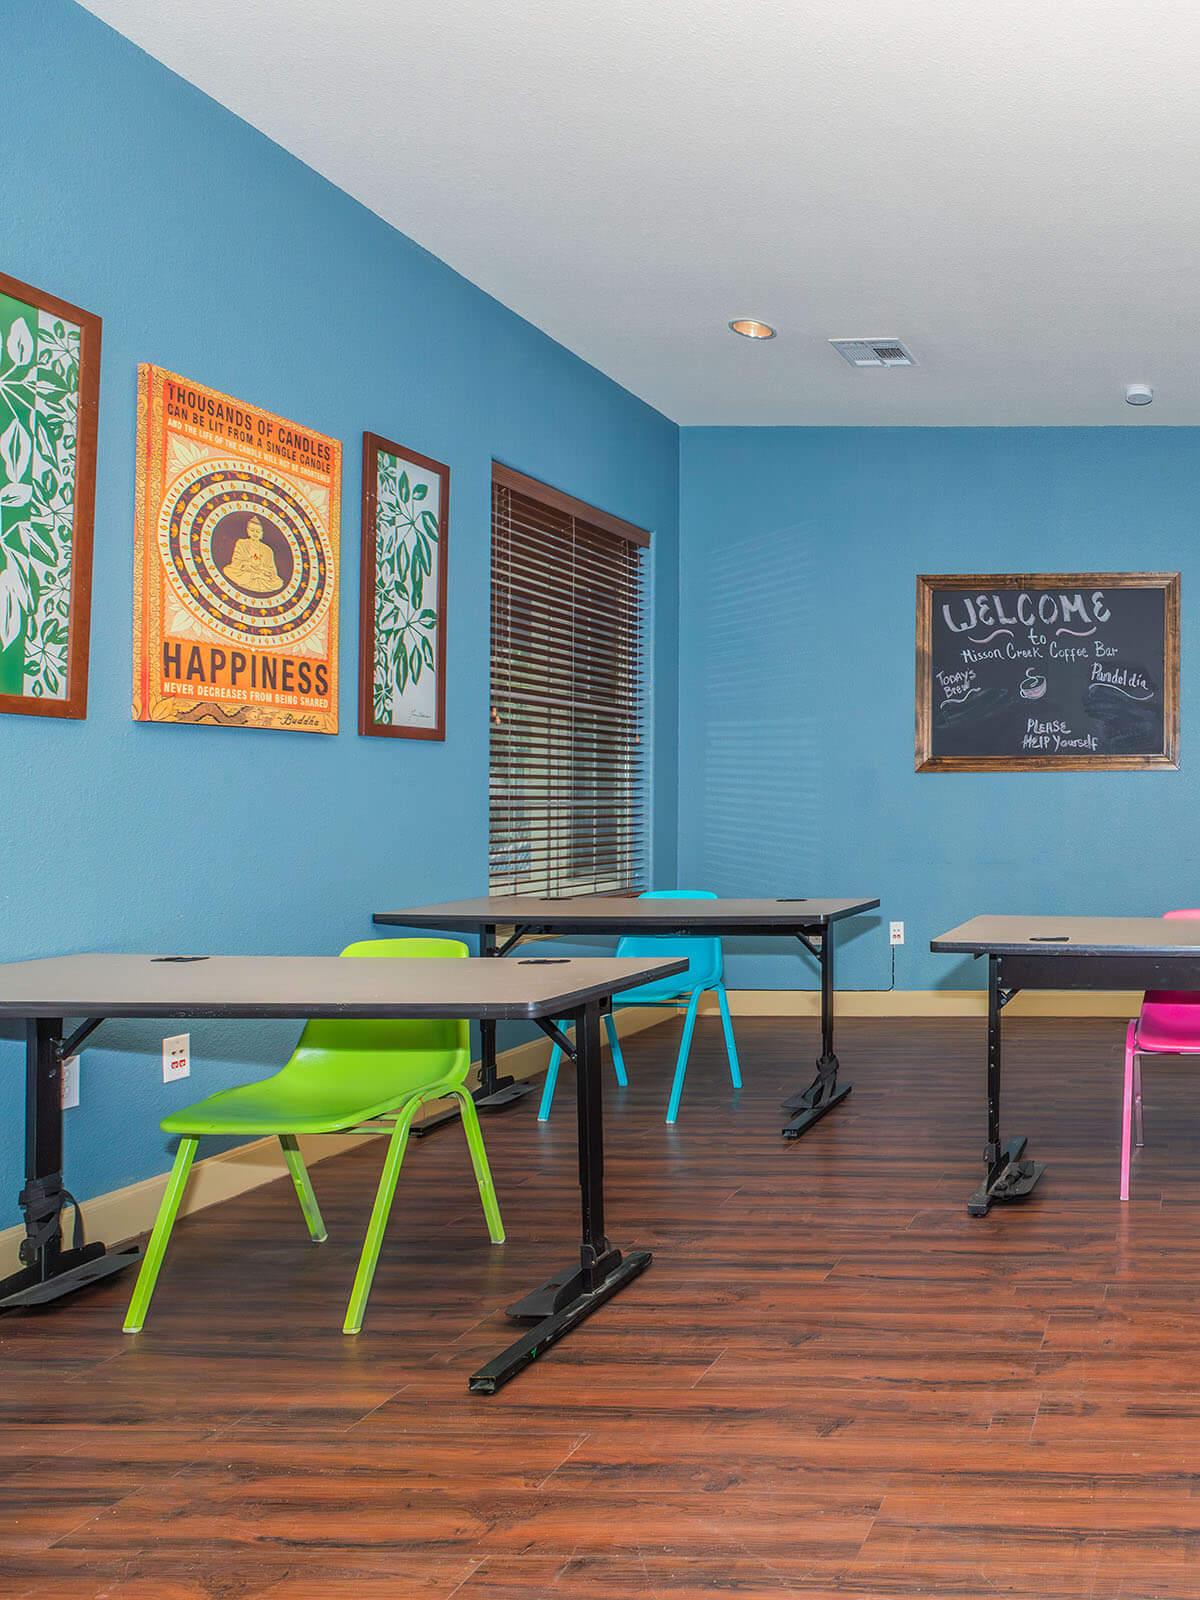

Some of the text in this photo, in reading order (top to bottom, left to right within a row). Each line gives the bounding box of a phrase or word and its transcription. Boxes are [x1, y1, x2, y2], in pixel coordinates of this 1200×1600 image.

[167, 383, 331, 461] THOUSANDS OF CANDLES
[167, 403, 331, 474] CAN BE LIT FROM A SINGLE CANDLE
[184, 423, 198, 436] THE
[199, 429, 213, 442] LIFE
[942, 591, 1112, 633] WELCOME
[1006, 642, 1043, 660] Creek
[1050, 641, 1088, 663] Coffee
[1094, 641, 1118, 657] Bar
[1027, 628, 1047, 646] to
[163, 642, 329, 696] HAPPINESS
[163, 682, 329, 709] NEVER DECREASES FROM BEING SHARED
